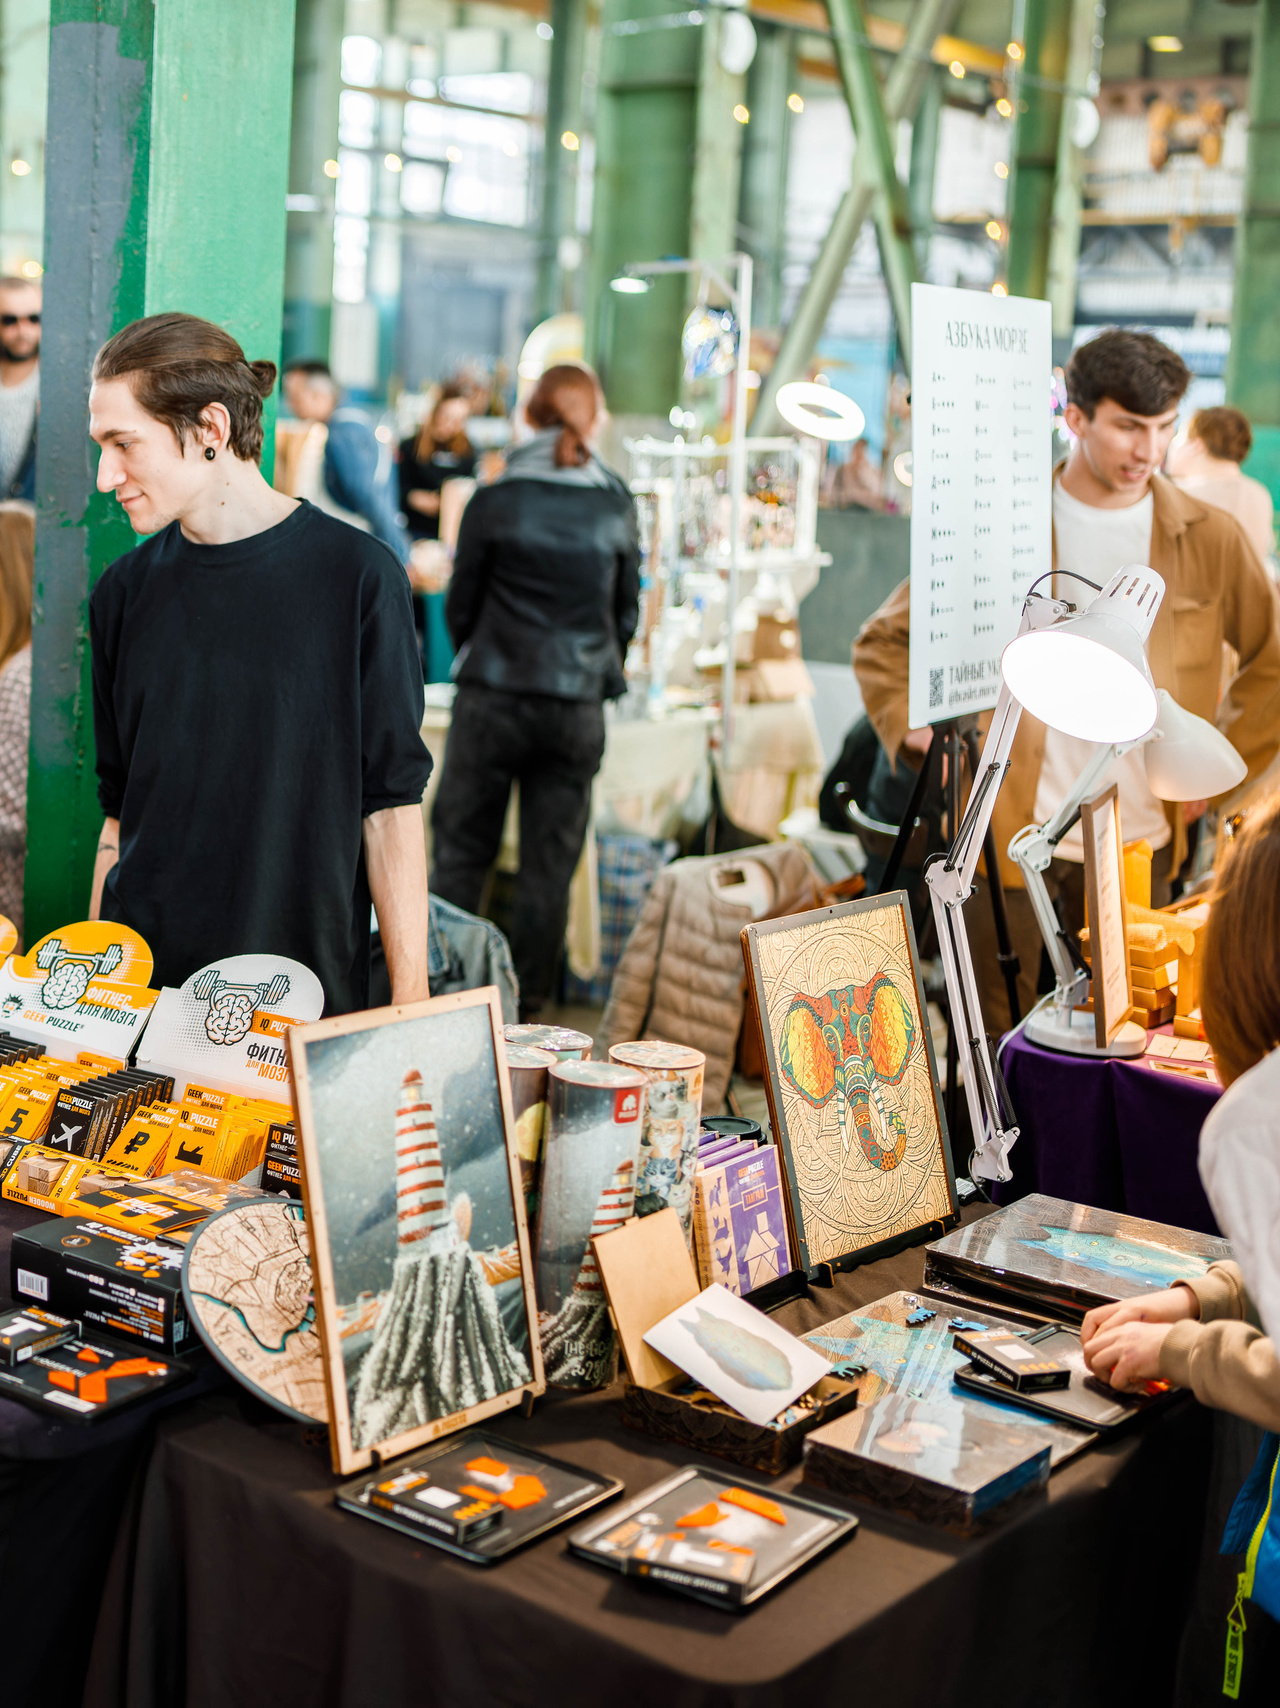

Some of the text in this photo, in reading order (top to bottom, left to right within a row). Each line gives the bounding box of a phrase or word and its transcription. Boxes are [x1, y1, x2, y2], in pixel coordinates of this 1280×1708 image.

[945, 320, 1029, 355] АЗБУКА МОРЗЕ
[949, 659, 985, 685] ТАЙНЫЕ
[86, 986, 133, 1008] ФИТНЕС
[23, 1009, 81, 1033] GEEK PUZZLE
[75, 1001, 138, 1027] ДЛЯ МОЗГА
[259, 1018, 270, 1032] IQ
[247, 1043, 288, 1067] ФИТН
[245, 1059, 291, 1084] ДЛЯ МОЗГ
[18, 1086, 52, 1101] GEEKPUZZLE
[58, 1093, 94, 1111] GEEKPUZZLE
[187, 1088, 225, 1104] GEEKPUZZLE
[136, 1110, 175, 1125] GEEKPUZZLE
[178, 1122, 194, 1131] ФИТНЕС
[180, 1110, 218, 1129] IQ PUZZLE
[271, 1130, 282, 1143] IQ
[6, 1145, 23, 1167] CUBE
[54, 1164, 78, 1198] 3D CUBE
[6, 1188, 56, 1211] WOODEN PUZZLE
